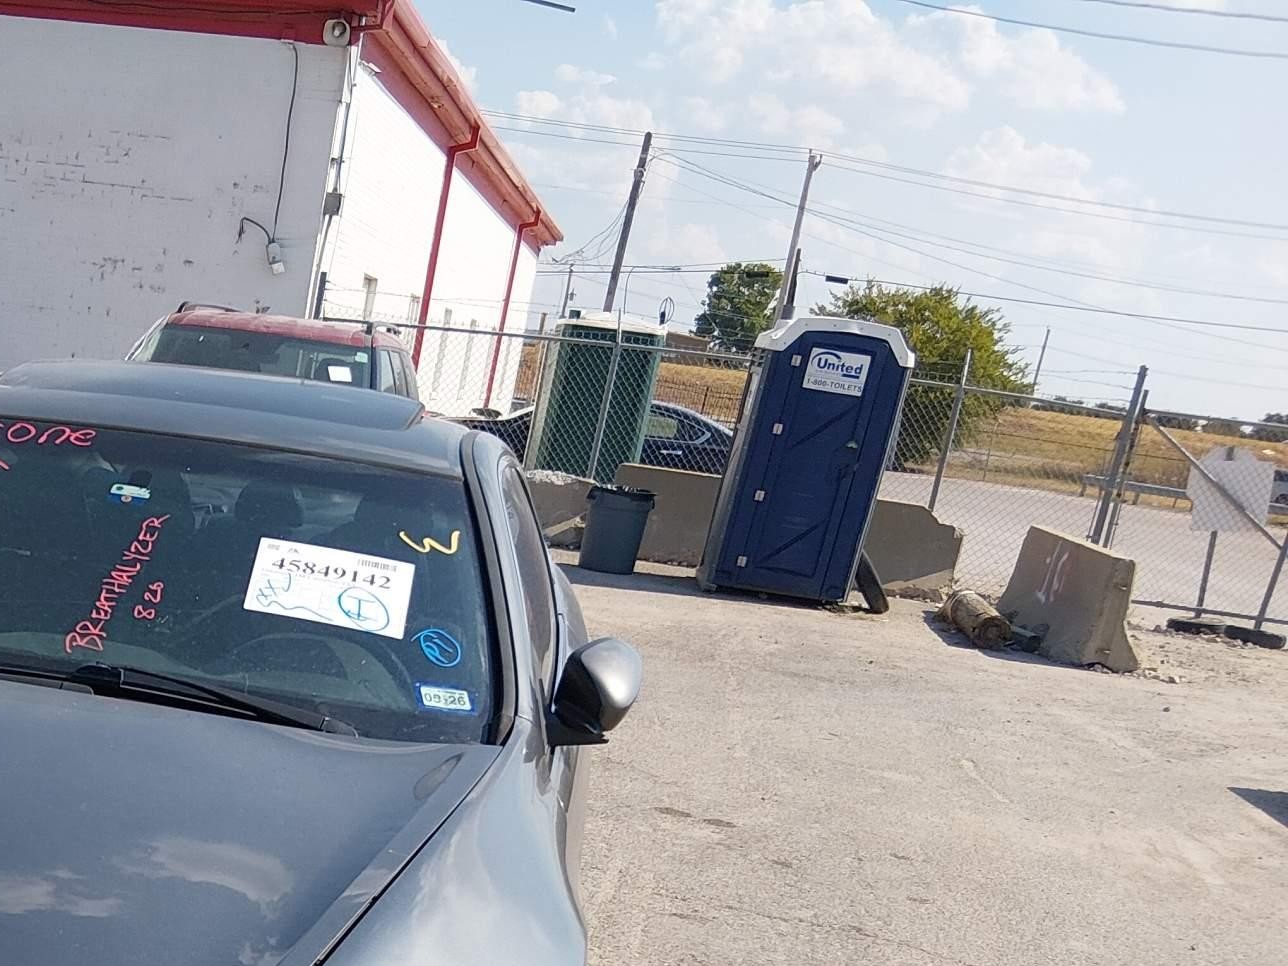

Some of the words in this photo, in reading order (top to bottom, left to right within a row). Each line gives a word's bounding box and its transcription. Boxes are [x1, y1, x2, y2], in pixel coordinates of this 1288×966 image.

[817, 357, 863, 374] United
[807, 378, 862, 392] 1-800-TOILETS
[66, 514, 171, 654] BREATHALYZER
[272, 557, 392, 589] 45849142
